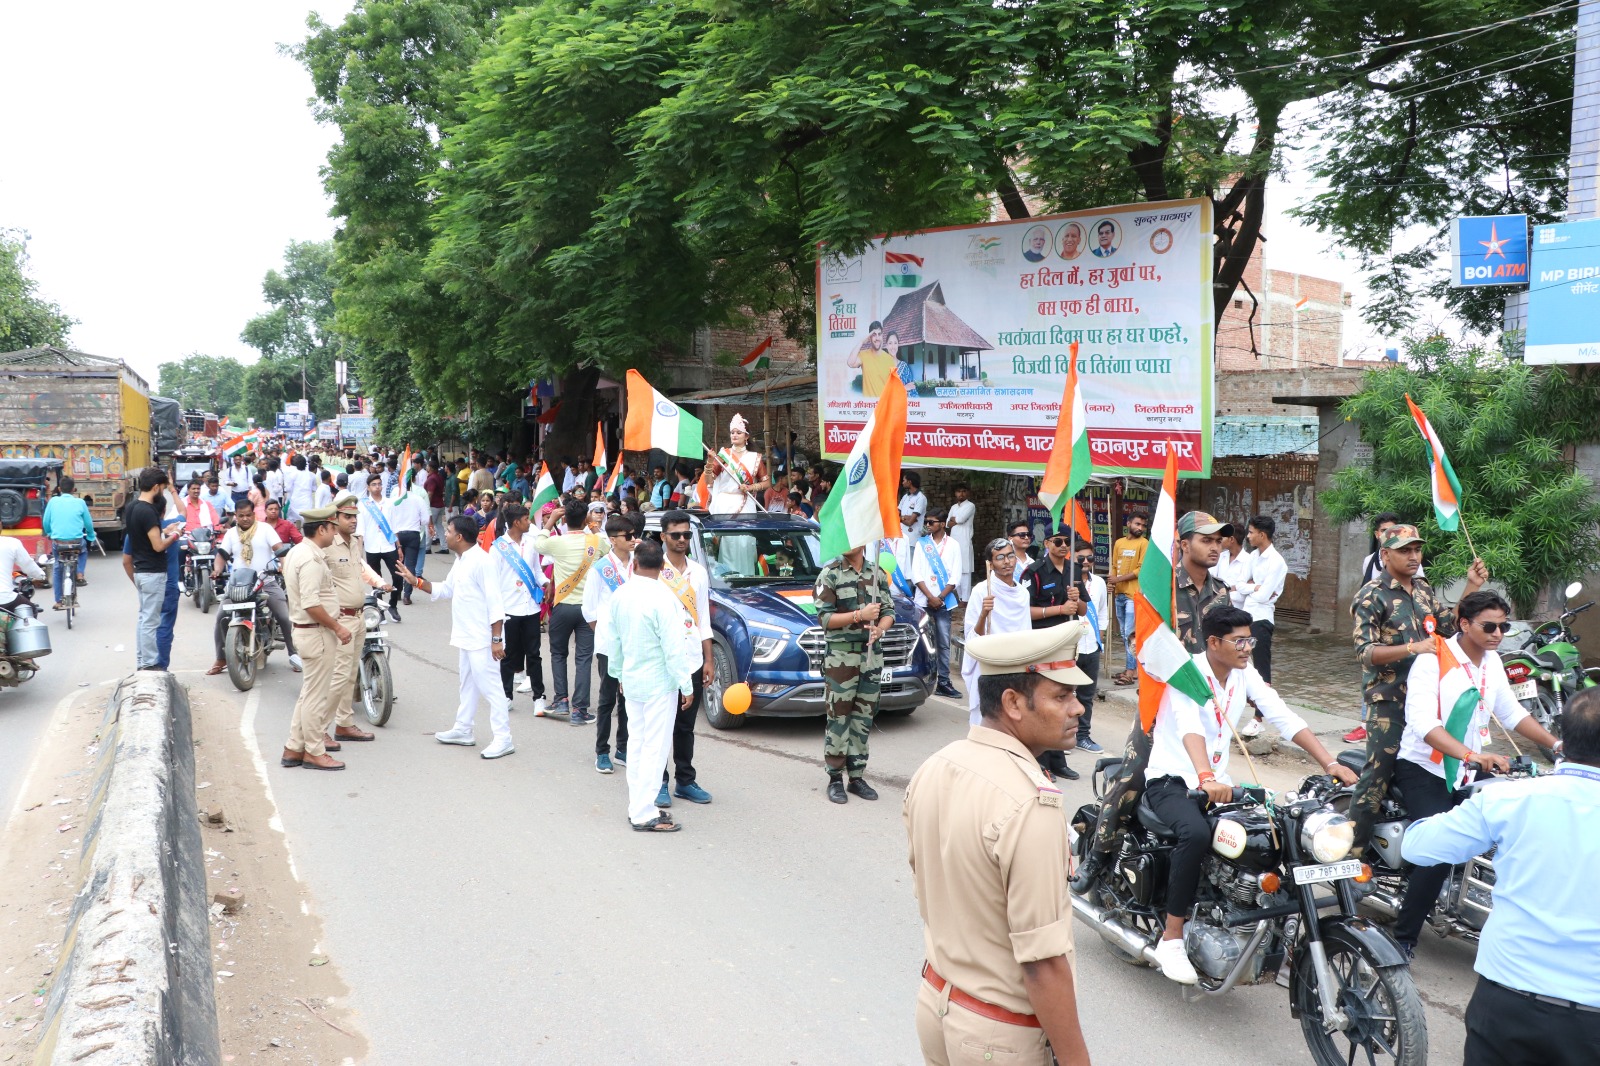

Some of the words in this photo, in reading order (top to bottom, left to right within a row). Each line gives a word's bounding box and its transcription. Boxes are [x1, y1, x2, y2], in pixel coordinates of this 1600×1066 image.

[1020, 273, 1035, 289] हर
[1037, 267, 1063, 287] दिल
[1068, 266, 1084, 286] में,
[1088, 268, 1104, 284] हर
[1107, 263, 1136, 288] जुबां
[1139, 264, 1162, 282] पर,
[1465, 265, 1492, 280] BOI
[1493, 263, 1526, 277] ATM
[1540, 270, 1565, 282] MP
[1567, 266, 1600, 280] BIRL
[1037, 301, 1056, 316] बस
[1059, 300, 1082, 317] एक
[1085, 294, 1101, 316] ही
[1104, 297, 1140, 315] नारा,
[829, 313, 857, 331] तिरंगा
[998, 328, 1046, 346] स्वतंत्रता
[1050, 325, 1084, 344] दिवस
[1086, 329, 1103, 344] पर
[1106, 328, 1123, 345] हर
[1126, 328, 1145, 343] घर
[1148, 322, 1189, 345] फहरे,
[1012, 354, 1051, 374] विजयी
[1090, 353, 1132, 374] तिरंगा
[1135, 358, 1172, 374] प्यारा
[1010, 403, 1029, 412] अपर
[1084, 402, 1115, 414] (नगर)
[1134, 403, 1194, 414] जिलाधिकारी
[924, 427, 971, 448] पालिका
[973, 429, 1020, 452] परिषद,
[1090, 438, 1149, 461] कानपुर
[1217, 835, 1238, 849] ENFIELD
[1220, 829, 1236, 841] ROYAL
[1304, 869, 1316, 880] UP
